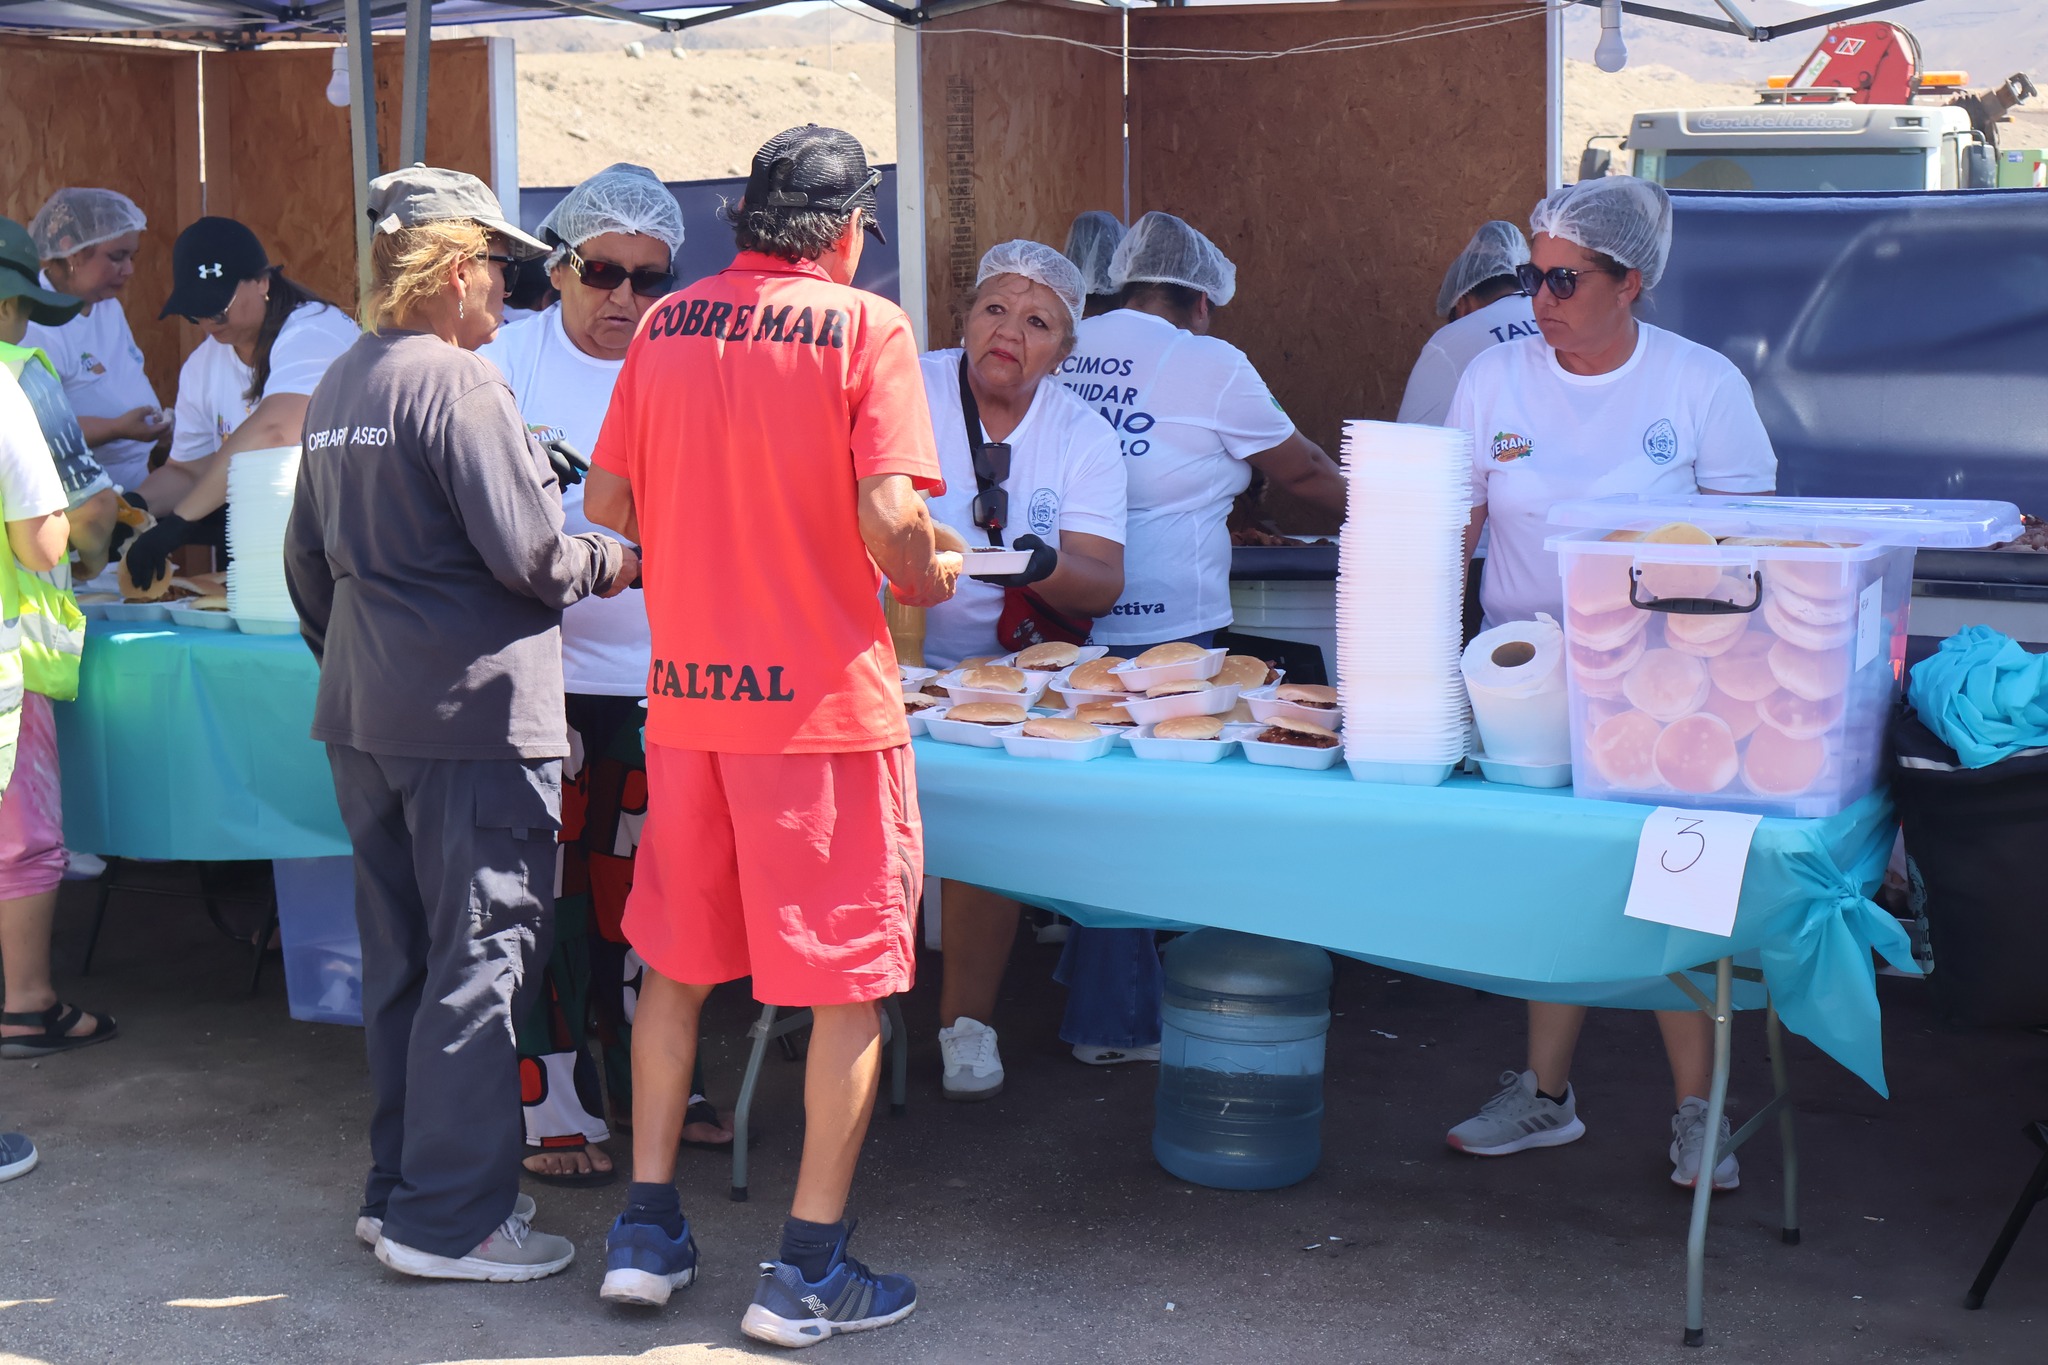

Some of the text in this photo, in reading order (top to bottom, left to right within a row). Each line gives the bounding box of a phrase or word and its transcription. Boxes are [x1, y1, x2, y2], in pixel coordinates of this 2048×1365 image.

[1699, 112, 1853, 129] Constellation
[1061, 355, 1134, 376] CIMOS
[1099, 406, 1156, 434] NO
[350, 426, 388, 447] ASEO
[1120, 439, 1150, 456] LO
[1491, 437, 1535, 459] VERANO
[1109, 602, 1165, 615] ctiva
[652, 659, 794, 701] TALTAL
[1661, 817, 1704, 872] 3
